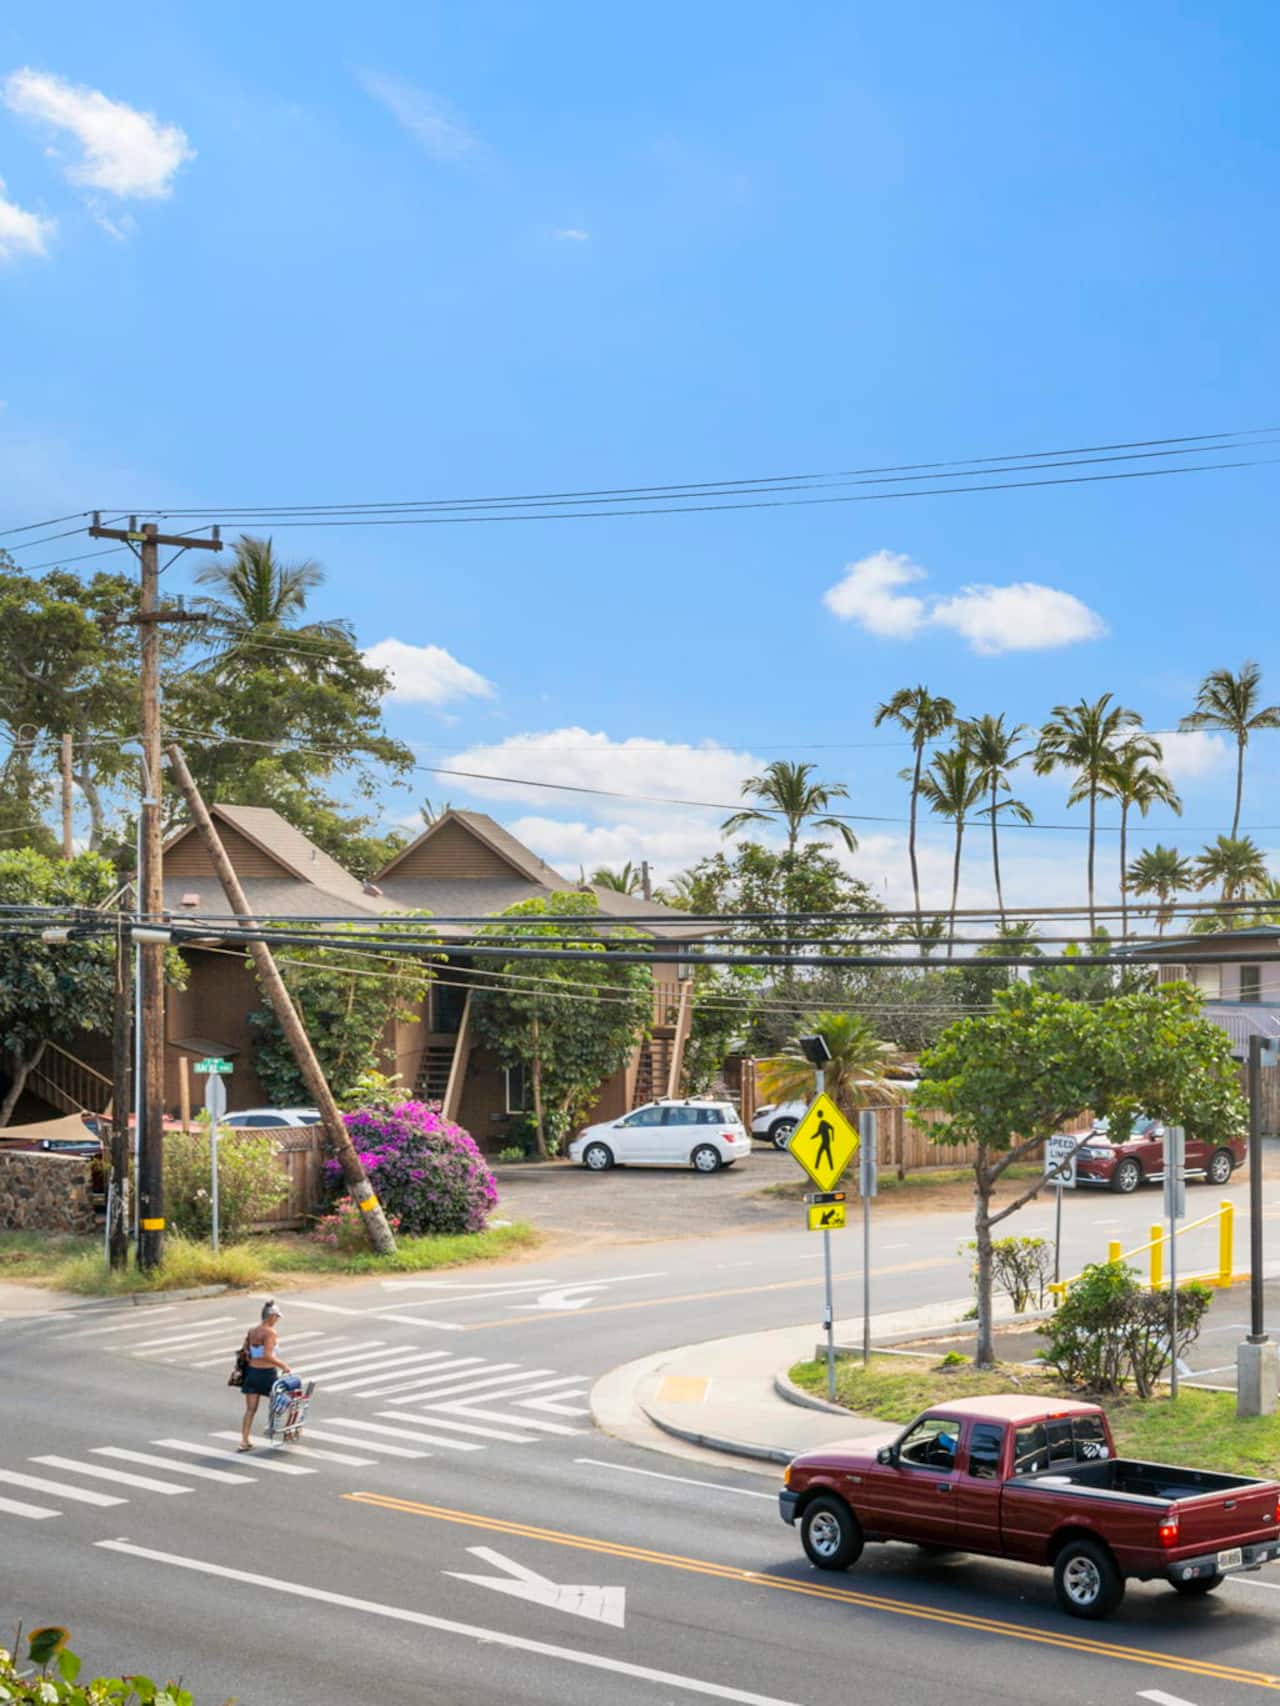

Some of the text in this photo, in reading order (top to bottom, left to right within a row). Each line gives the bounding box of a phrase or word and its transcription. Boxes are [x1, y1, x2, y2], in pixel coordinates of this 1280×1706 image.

[1048, 1138, 1074, 1149] SPEED
[1050, 1149, 1071, 1158] LIMI
[1048, 1161, 1072, 1181] 20
